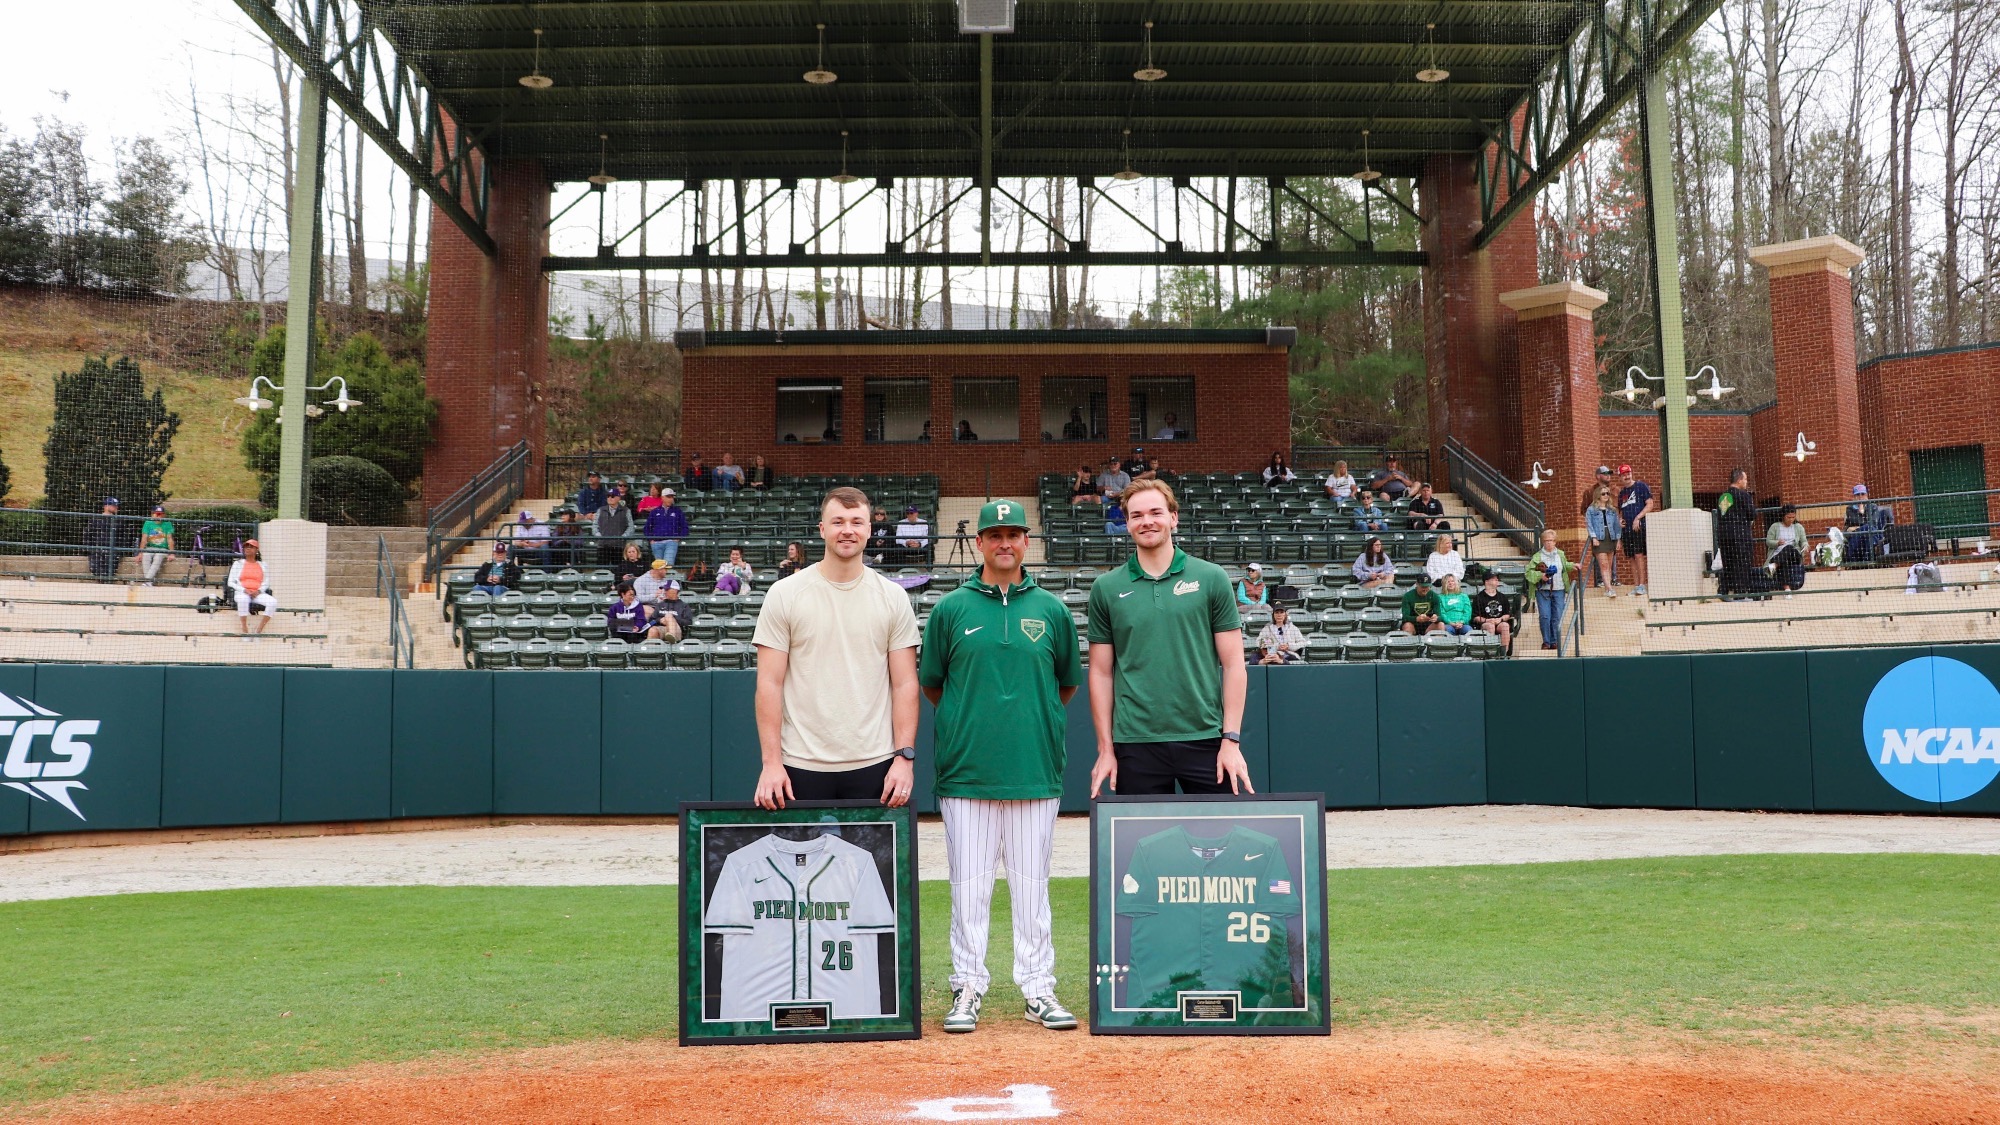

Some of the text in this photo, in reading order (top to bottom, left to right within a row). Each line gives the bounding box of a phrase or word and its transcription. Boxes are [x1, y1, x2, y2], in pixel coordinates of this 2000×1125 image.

[996, 504, 1011, 521] P
[1880, 727, 2000, 765] NCAA
[1157, 876, 1257, 904] PIEDMONT
[753, 899, 850, 920] PIEDMONT
[1227, 911, 1271, 944] 26
[821, 940, 853, 971] 26
